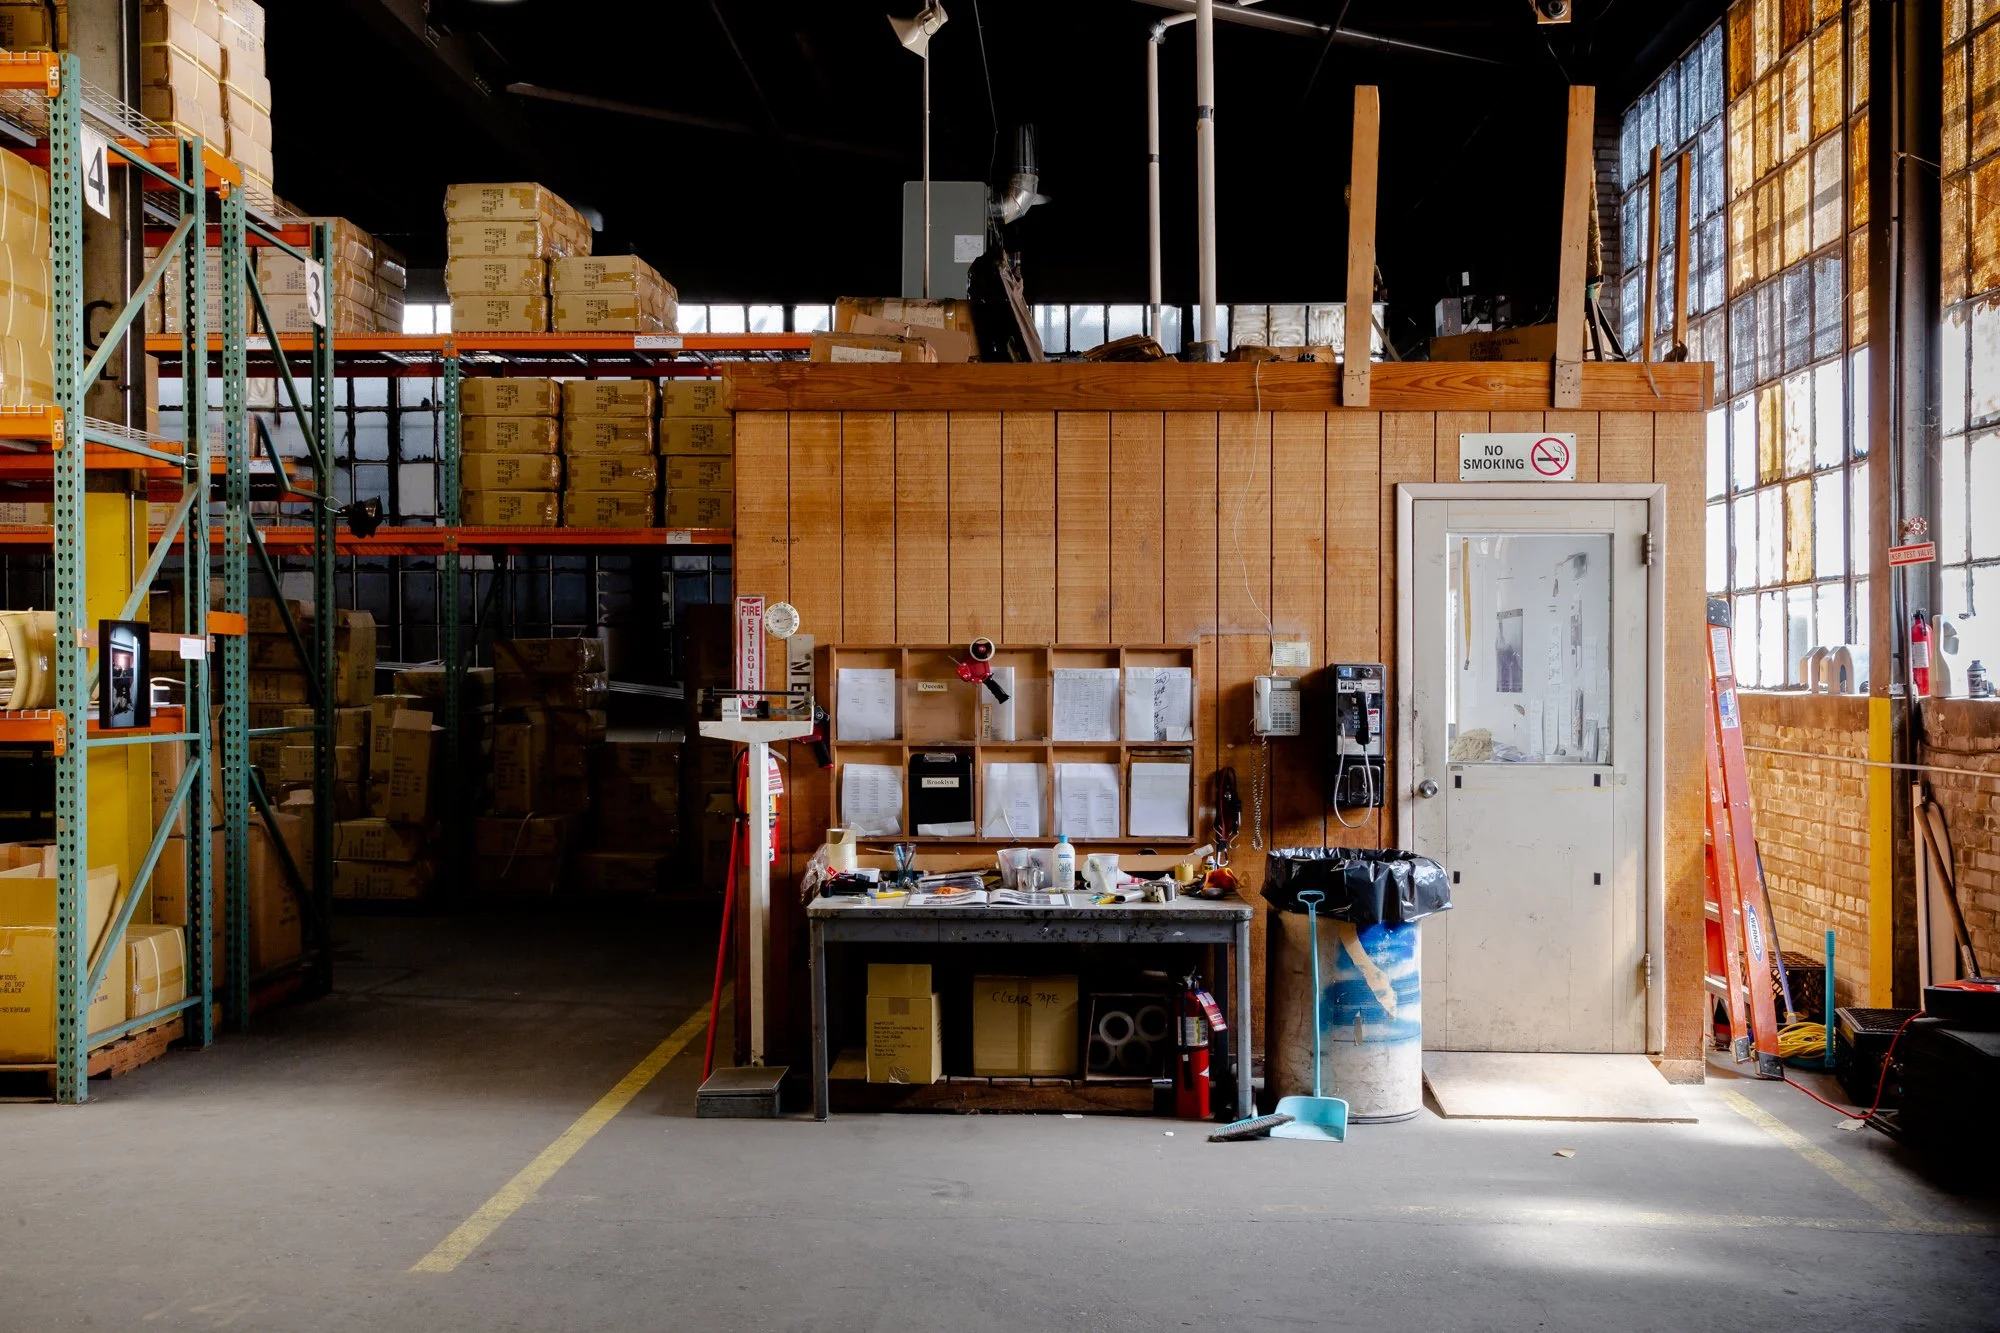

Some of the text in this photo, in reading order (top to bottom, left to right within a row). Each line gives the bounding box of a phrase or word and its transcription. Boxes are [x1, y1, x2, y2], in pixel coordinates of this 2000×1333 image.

[88, 147, 106, 207] 4
[309, 271, 321, 317] 3
[1484, 445, 1503, 456] NO
[1463, 458, 1525, 470] SMOKING
[1904, 550, 1916, 559] TEST
[1917, 548, 1933, 557] VALVE
[741, 606, 761, 616] FIRE
[983, 724, 991, 739] Long
[926, 777, 954, 786] Brooklyn
[1750, 917, 1760, 951] WERNER
[992, 990, 1060, 1008] CLEAR TAPE
